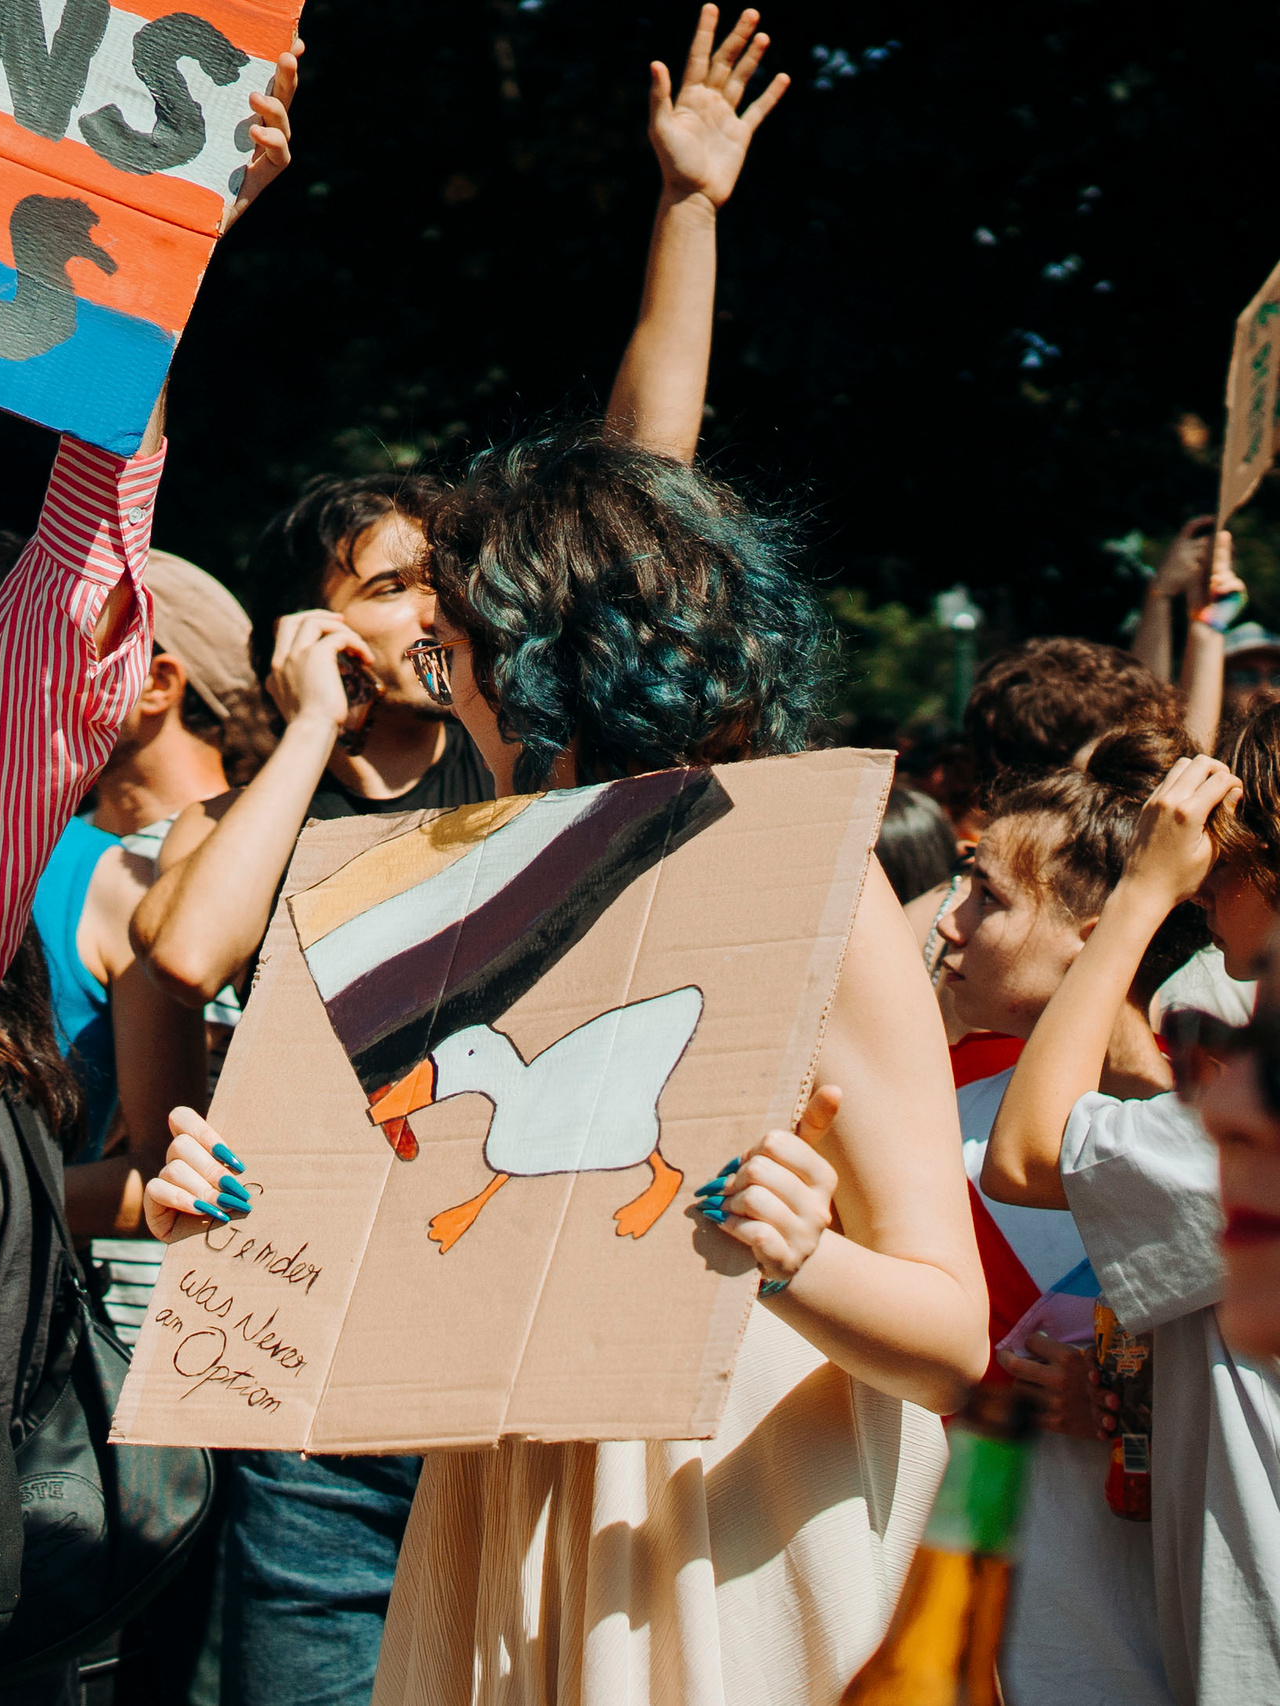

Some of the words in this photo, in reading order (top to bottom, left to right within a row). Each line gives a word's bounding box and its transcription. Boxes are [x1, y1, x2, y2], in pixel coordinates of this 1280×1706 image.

[154, 1308, 183, 1333] an
[173, 1325, 283, 1415] Option
[179, 1269, 234, 1318] was
[233, 1307, 307, 1378] Never
